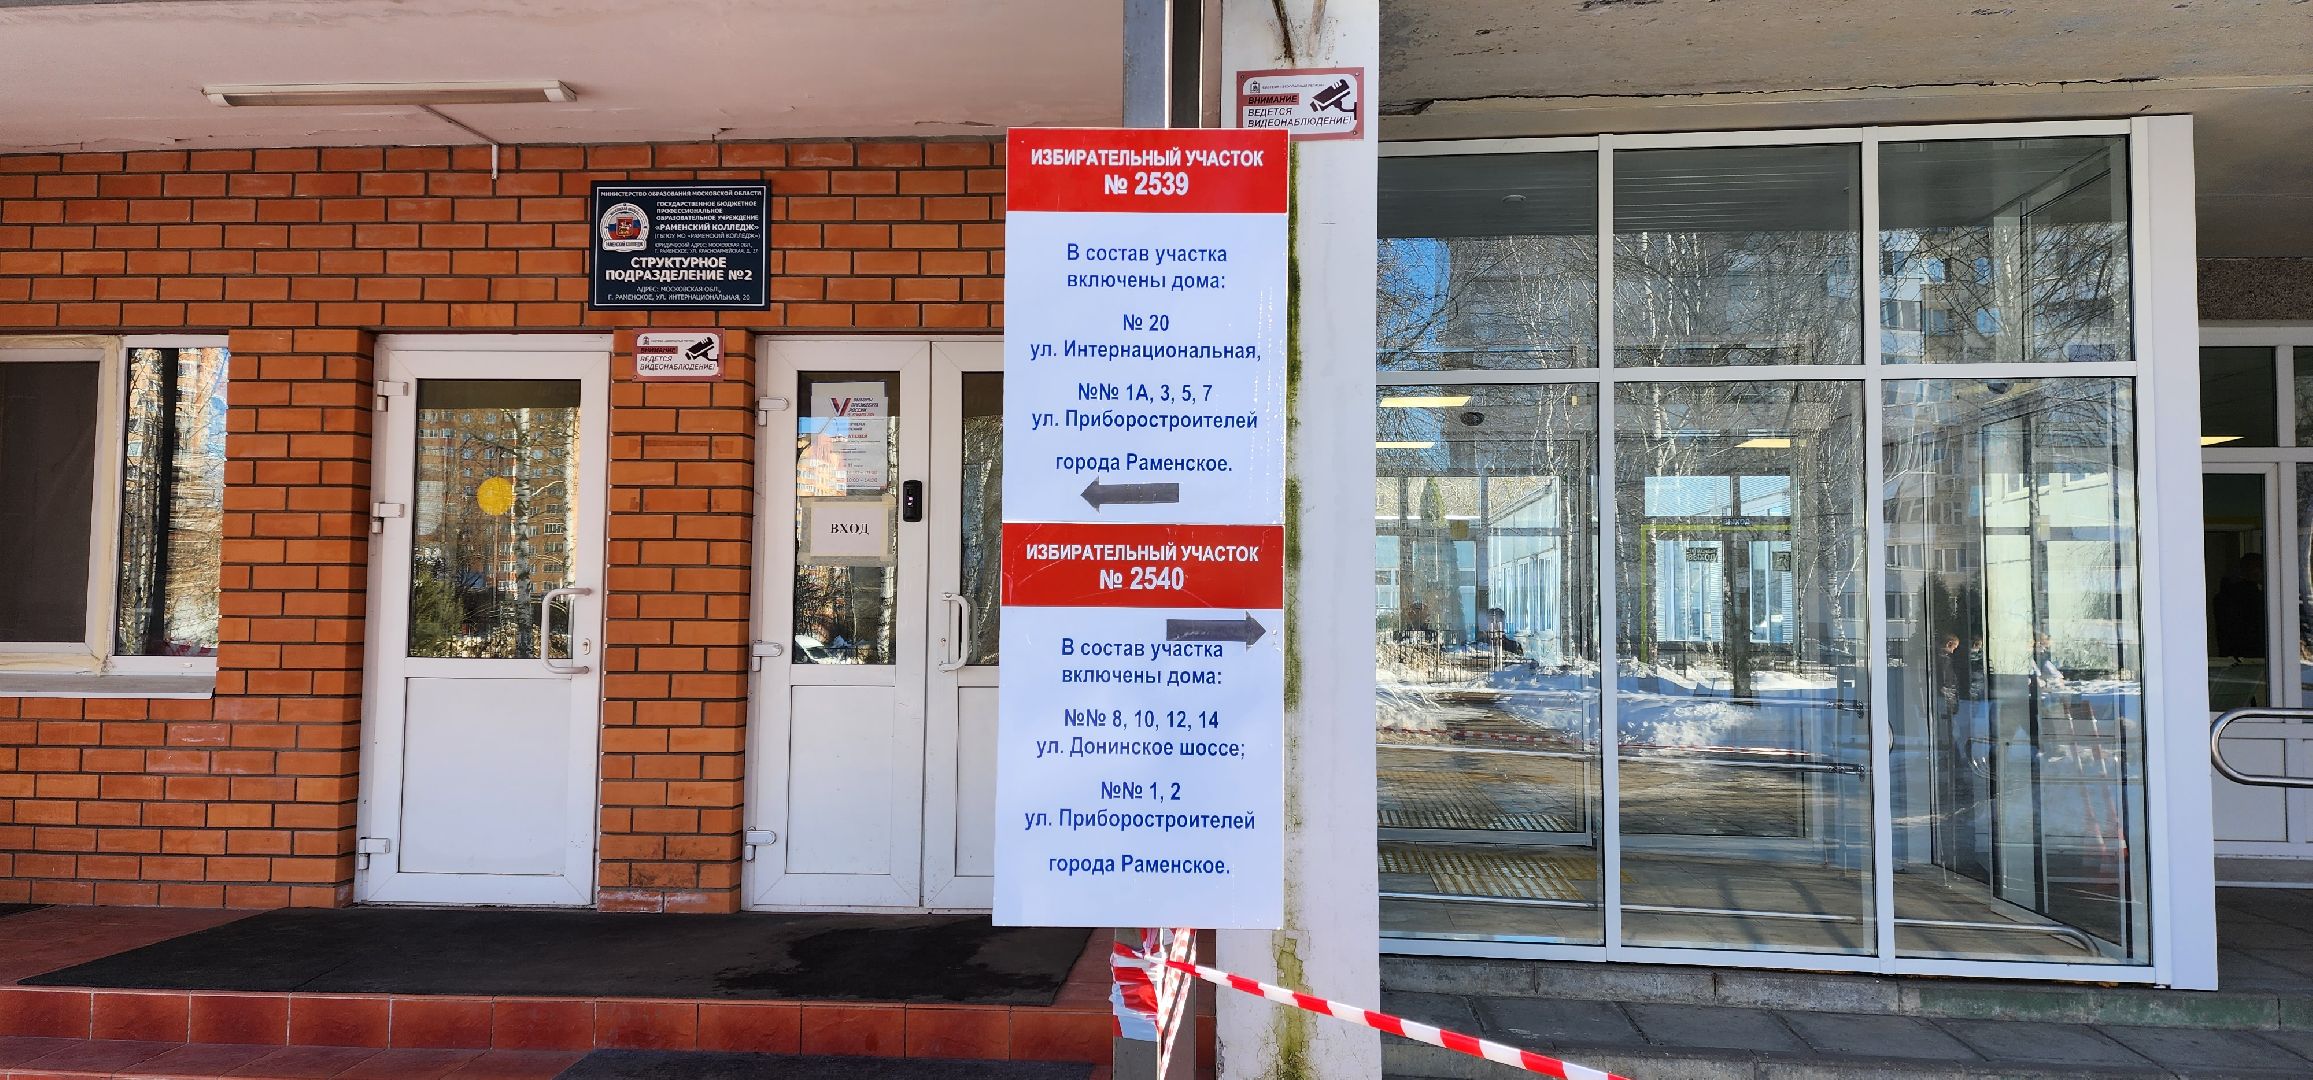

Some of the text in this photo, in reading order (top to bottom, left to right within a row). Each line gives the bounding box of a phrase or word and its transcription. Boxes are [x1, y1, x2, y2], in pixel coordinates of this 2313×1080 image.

[1248, 95, 1297, 104] ВНИМАНИЕ
[1248, 108, 1292, 117] ВЕДЕТСЯ
[1248, 116, 1351, 128] ВИДЕОНАБЛЮДЕНИЕ!
[1032, 147, 1264, 167] ИЗБИРАТЕЛЬНЫЙ УЧАСТОК
[1105, 172, 1188, 195] № 2539
[655, 222, 710, 231] «РАМЕНСКИЙ
[630, 257, 726, 268] СТРУКТУРНОЕ
[1068, 243, 1227, 265] В состав участка
[606, 270, 752, 282] ПОДРАЗДЕЛЕНИЕ №2
[1068, 275, 1224, 291] включены дома:
[1124, 314, 1169, 331] № 20
[1031, 340, 1260, 361] ул. Интернациональная,
[640, 363, 715, 371] ВИДЕОНАБЛЮДЕНИЕ!
[1079, 383, 1212, 404] №№ 1А, 3, 5, 7
[1032, 409, 1257, 432] ул. Приборостроителей
[1056, 453, 1232, 474] города Раменское.
[830, 523, 869, 535] ВХОД
[1027, 542, 1259, 561] ИЗБИРАТЕЛЬНЫЙ УЧАСТОК
[1100, 567, 1184, 590] № 2540
[1062, 638, 1222, 661] В состав участка
[1062, 670, 1221, 687] включены дома:
[1065, 709, 1218, 731] №№ 8, 10, 12, 14
[1037, 737, 1244, 760] ул. Донинское шоссе;
[1101, 781, 1180, 803] №№ 1, 2
[1025, 808, 1254, 832] ул. Приборостроителей
[1050, 854, 1229, 876] города Раменское.
